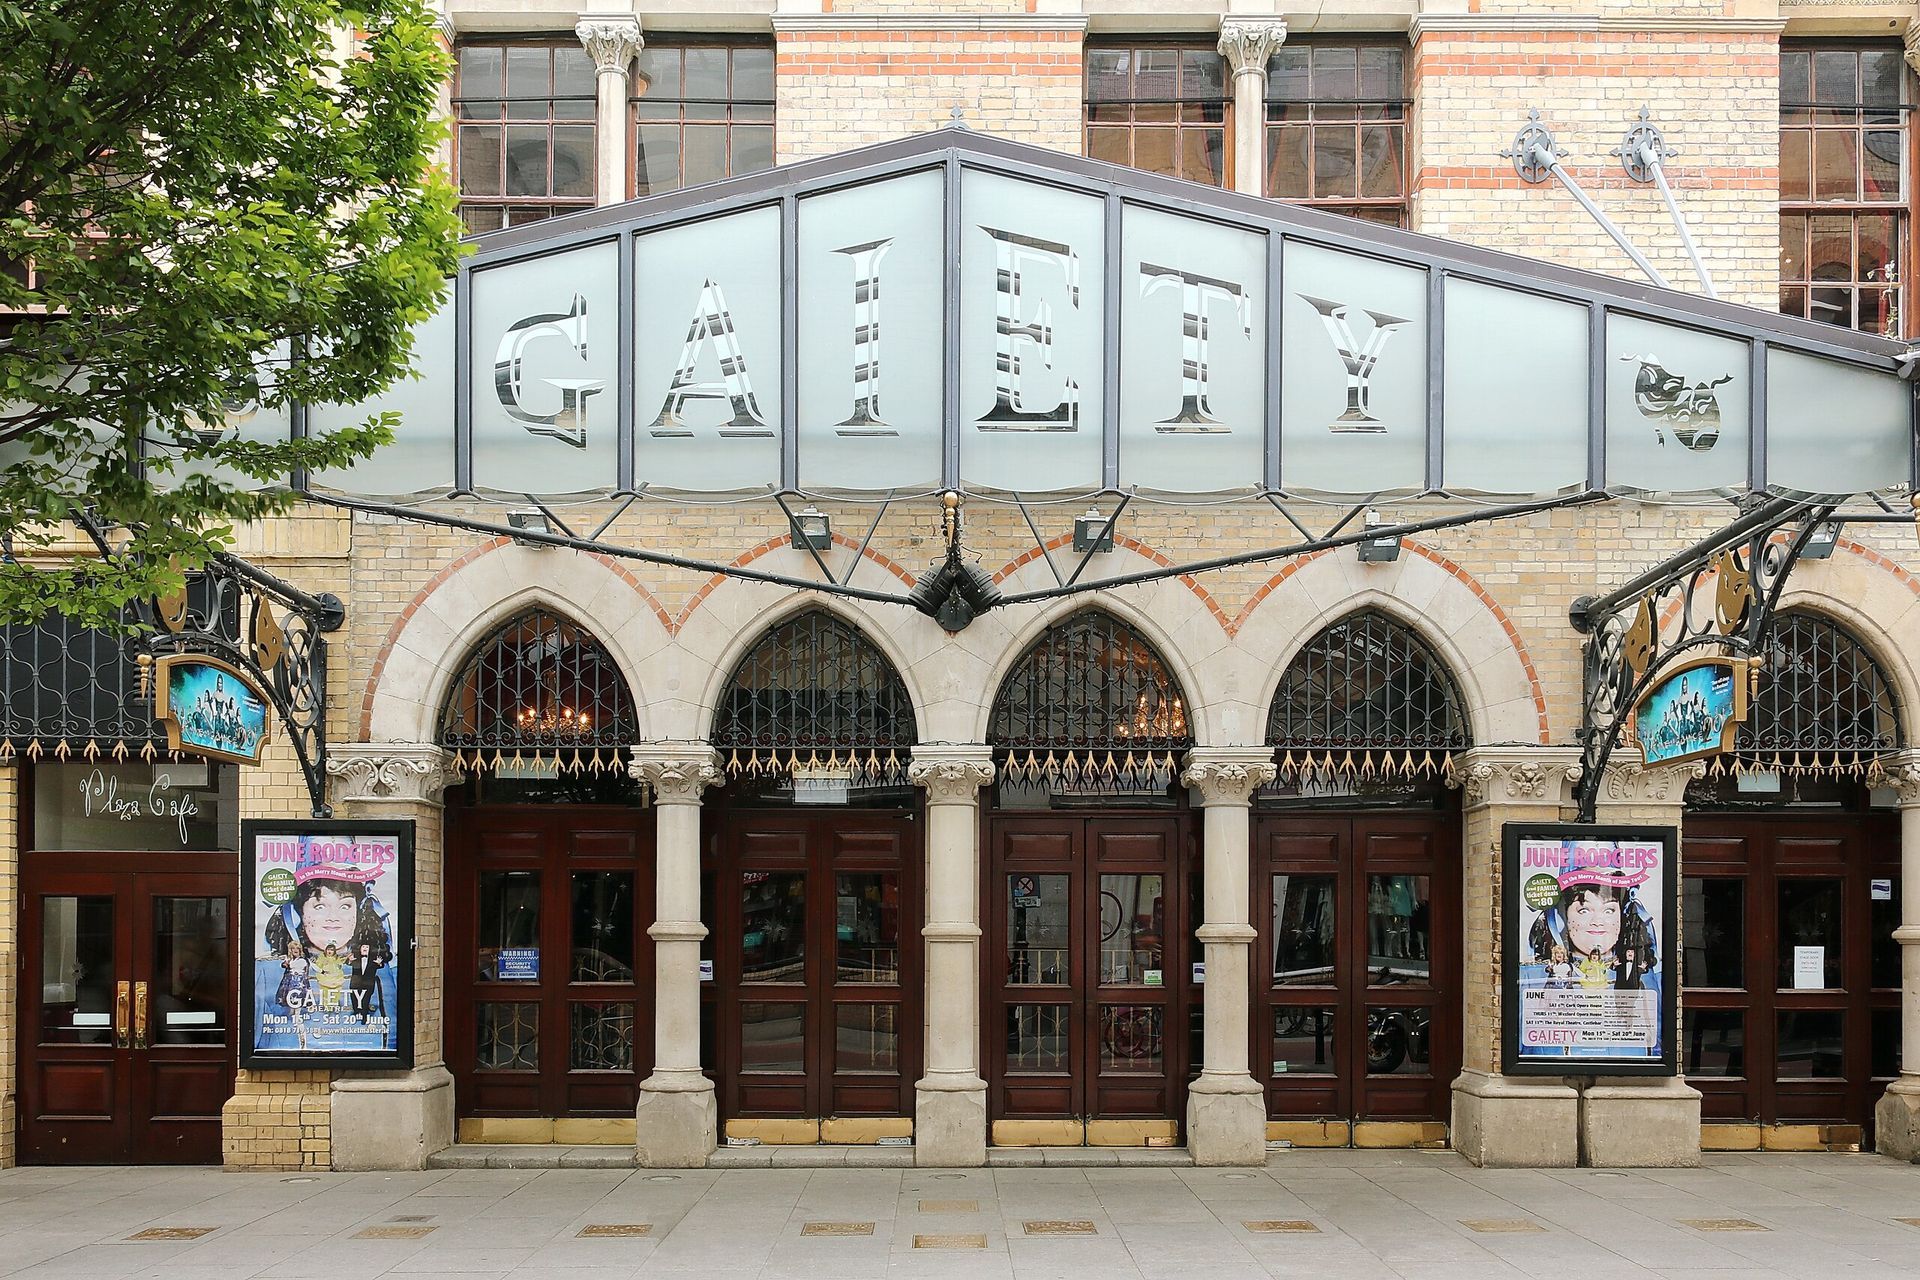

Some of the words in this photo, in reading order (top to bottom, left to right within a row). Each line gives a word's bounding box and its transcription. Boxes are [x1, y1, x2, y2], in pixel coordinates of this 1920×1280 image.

[494, 224, 1414, 450] GAIETY
[80, 768, 141, 820] Plaza
[149, 773, 199, 844] Cafe
[260, 842, 306, 863] JUNE
[311, 843, 396, 864] RODGERS
[1523, 847, 1570, 868] JUNE
[1574, 848, 1659, 869] RODGERS
[330, 870, 347, 878] Month
[365, 870, 379, 878] Tour
[1595, 875, 1612, 883] Month
[1630, 874, 1644, 883] Tour
[286, 989, 367, 1009] GAIETY
[1525, 991, 1545, 999] JUNE
[263, 1014, 288, 1025] Mon
[322, 1014, 340, 1025] Sat
[343, 1013, 364, 1025] 20th
[365, 1015, 391, 1026] June
[262, 1026, 274, 1034] Ph:
[274, 1026, 291, 1034] 0818
[322, 1026, 390, 1035] www.ticketmaster.ie
[1528, 1030, 1578, 1042] GAIETY
